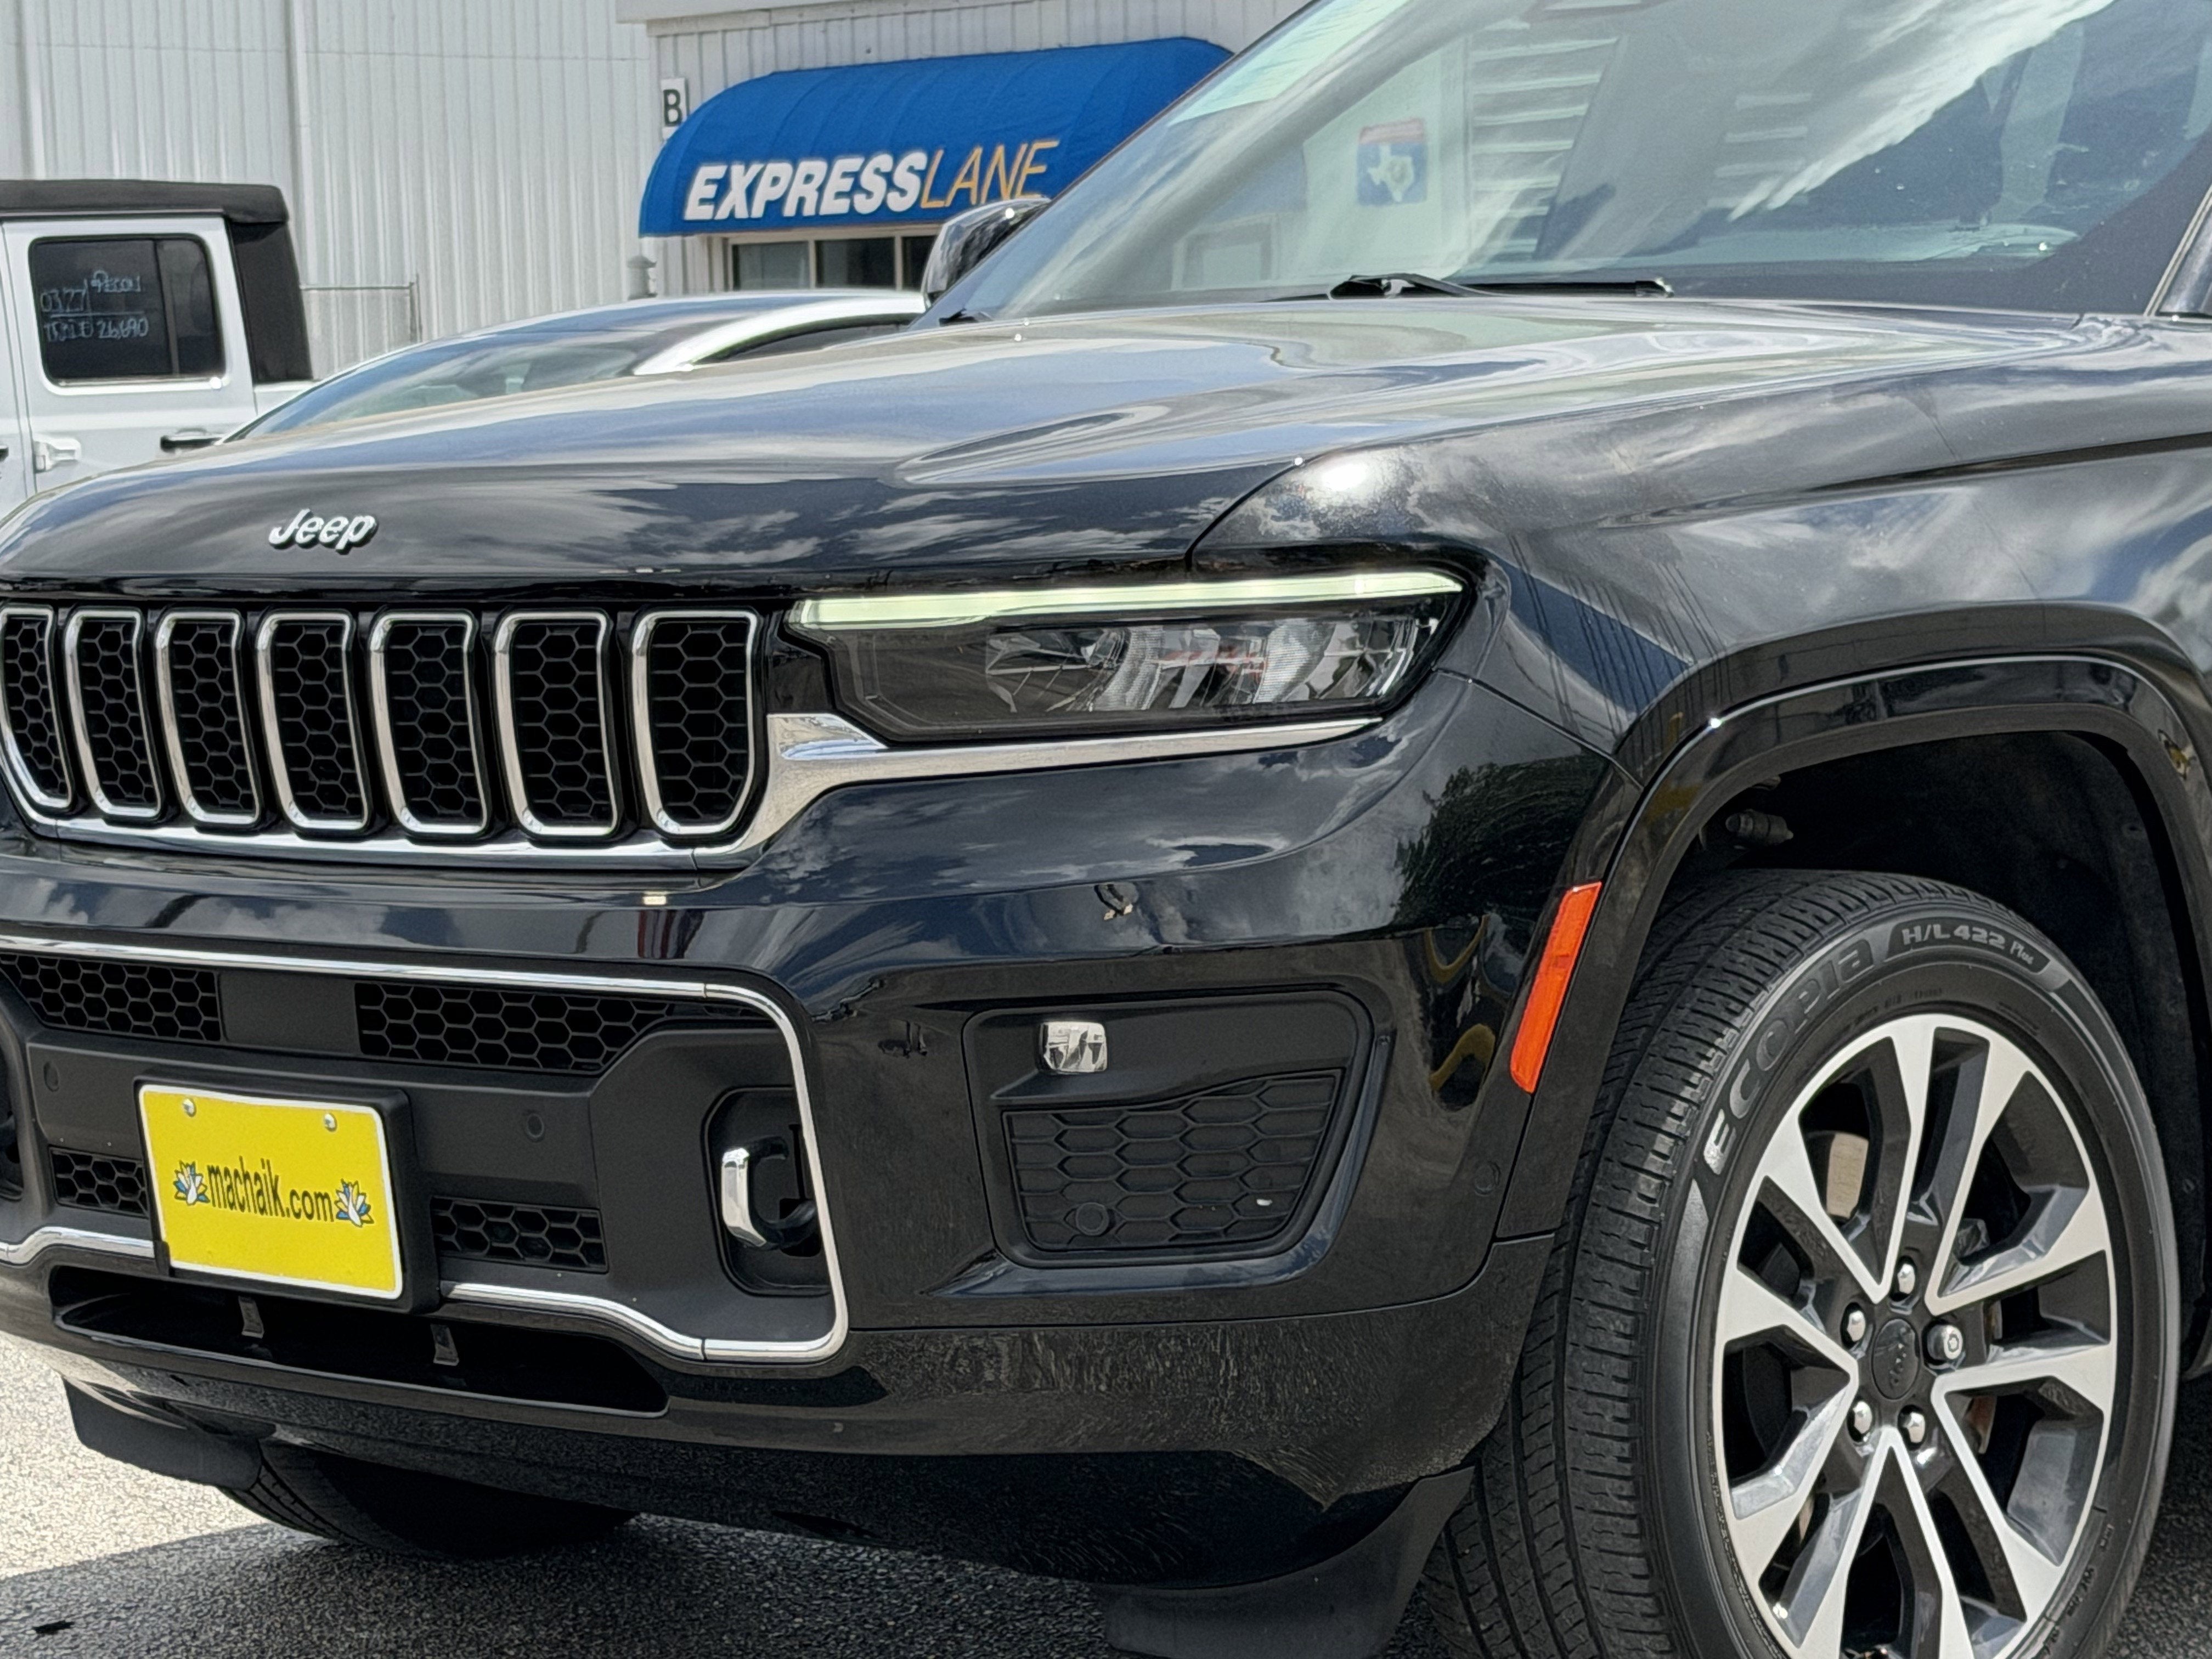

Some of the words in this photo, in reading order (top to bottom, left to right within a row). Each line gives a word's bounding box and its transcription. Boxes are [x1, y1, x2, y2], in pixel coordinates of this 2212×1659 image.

[663, 88, 681, 127] B
[268, 508, 377, 552] Jeep
[207, 1156, 334, 1223] machaik.com
